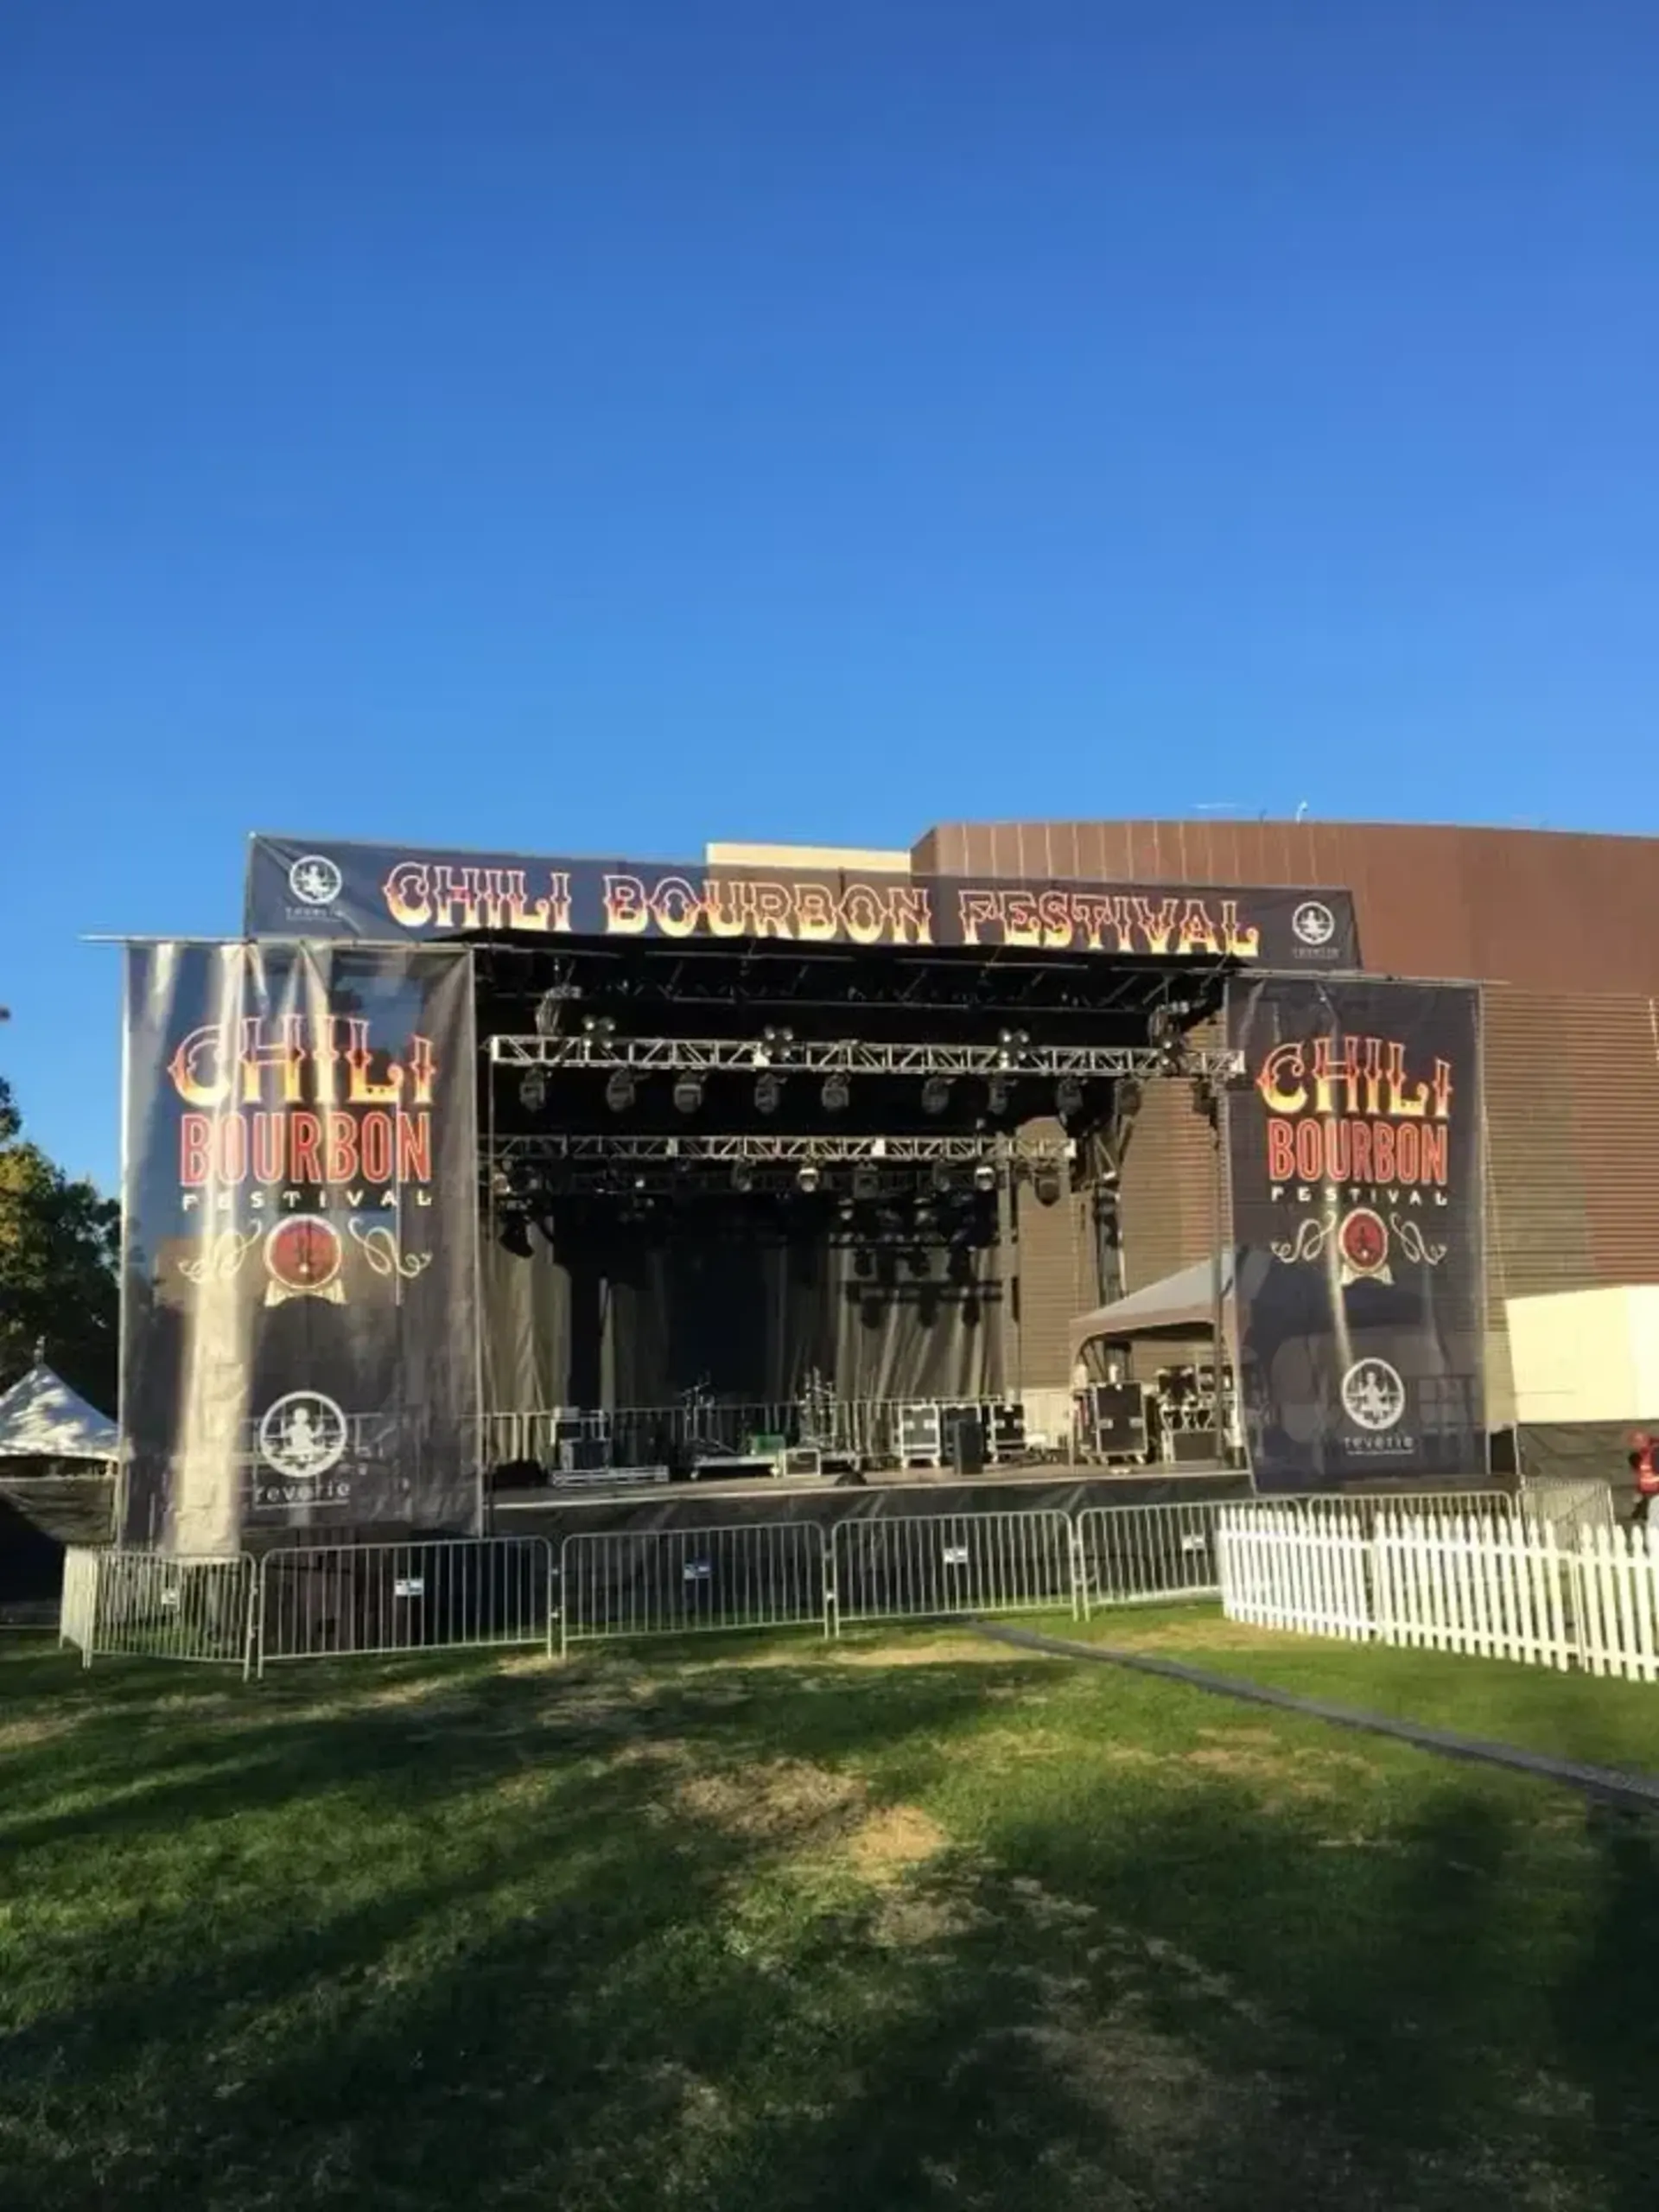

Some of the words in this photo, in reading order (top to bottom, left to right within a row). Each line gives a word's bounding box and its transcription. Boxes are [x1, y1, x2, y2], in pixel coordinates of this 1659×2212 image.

[382, 861, 572, 931] CHILI
[603, 874, 933, 944] BOURBON
[958, 888, 1260, 957] FESTIVAL
[168, 1015, 436, 1104] CHILI
[1255, 1036, 1453, 1117] CHILI
[180, 1111, 432, 1187] BOURBON
[1268, 1118, 1447, 1185] BOURBON
[182, 1191, 432, 1210] FESTIVAL
[1271, 1187, 1447, 1205] FESTIVAL
